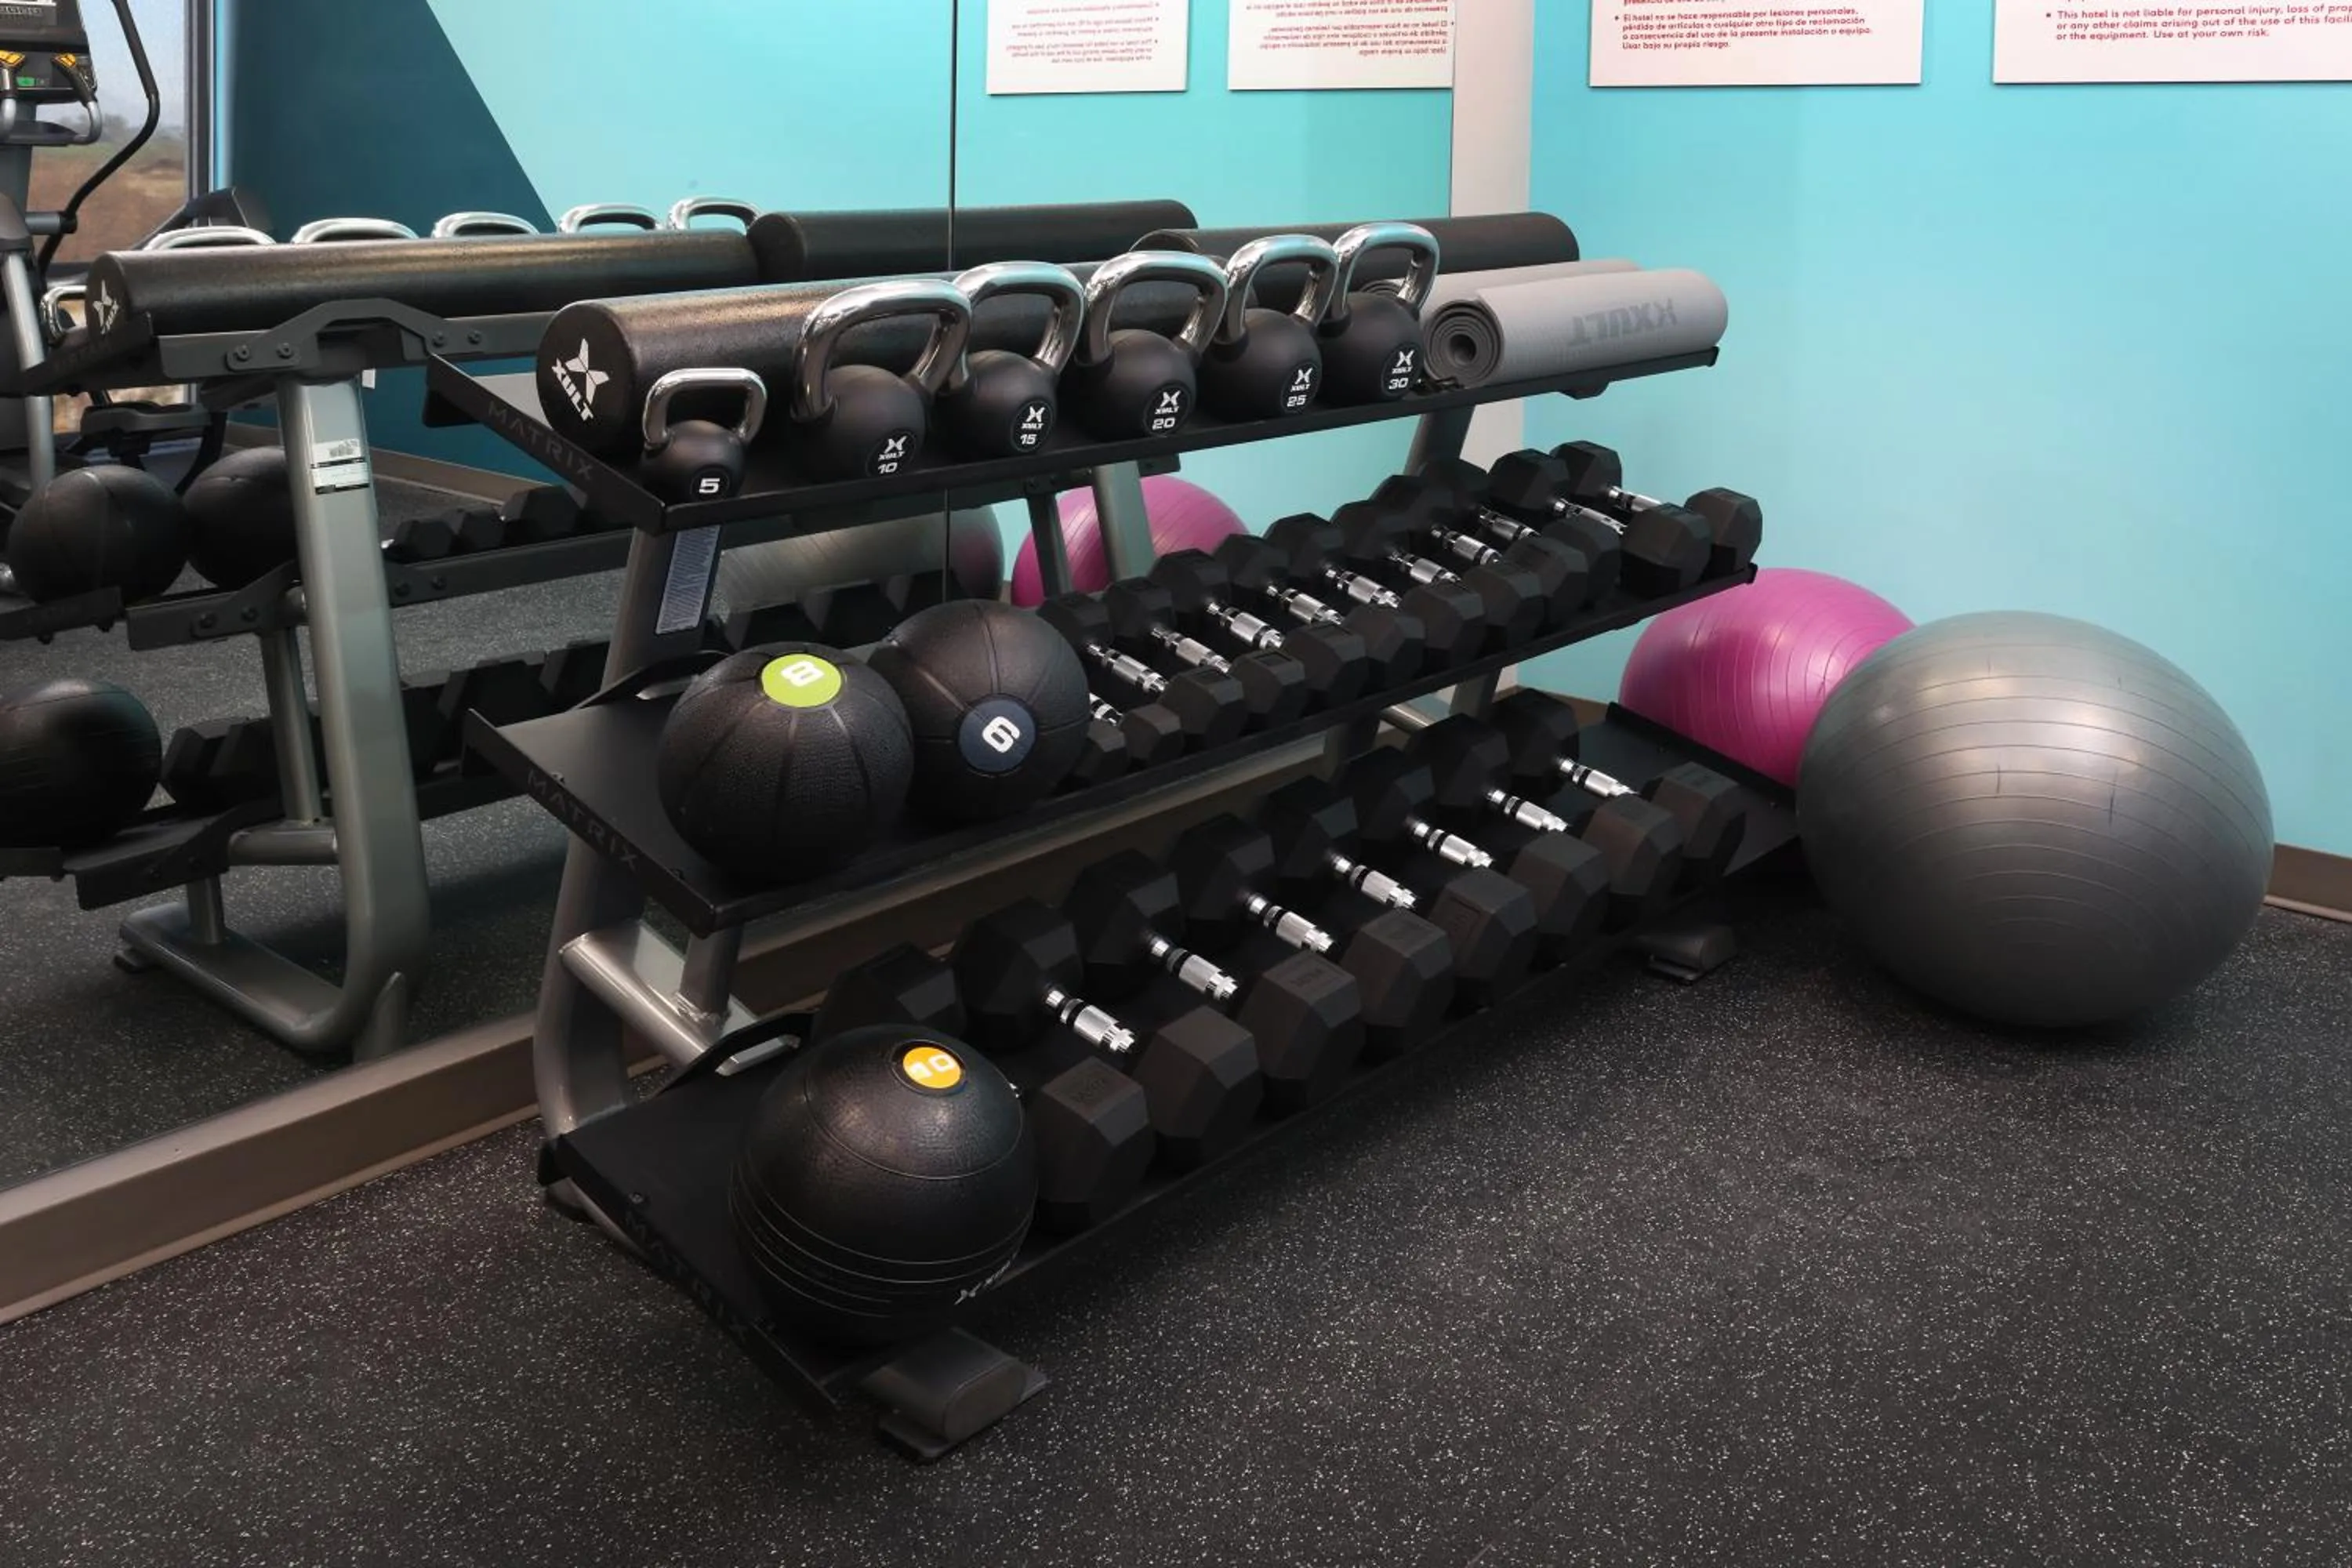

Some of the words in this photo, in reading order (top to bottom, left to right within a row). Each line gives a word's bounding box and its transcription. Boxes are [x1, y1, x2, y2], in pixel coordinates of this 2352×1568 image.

[1632, 13, 1653, 21] hotel
[1700, 10, 1751, 21] responsable
[1769, 9, 1805, 17] lesiones
[2082, 10, 2107, 19] hotel
[2111, 9, 2120, 18] is
[2143, 9, 2175, 17] liable
[2197, 6, 2245, 17] personal
[2287, 5, 2310, 13] loss
[1714, 19, 1753, 30] cualquier
[1776, 18, 1794, 28] tipo
[1795, 17, 1806, 26] de
[2092, 20, 2120, 29] other
[2122, 20, 2158, 28] claims
[2161, 19, 2198, 29] arising
[2201, 18, 2220, 27] out
[1686, 30, 1700, 38] del
[1740, 28, 1778, 38] presente
[1643, 41, 1661, 50] bajo
[1388, 377, 1409, 390] 30
[1287, 394, 1307, 407] 25
[1152, 417, 1175, 430] 20
[488, 400, 593, 481] MATRIX
[1020, 434, 1037, 445] 15
[878, 463, 898, 474] 10
[699, 477, 720, 493] 5
[781, 660, 824, 687] 8
[982, 715, 1020, 753] 6
